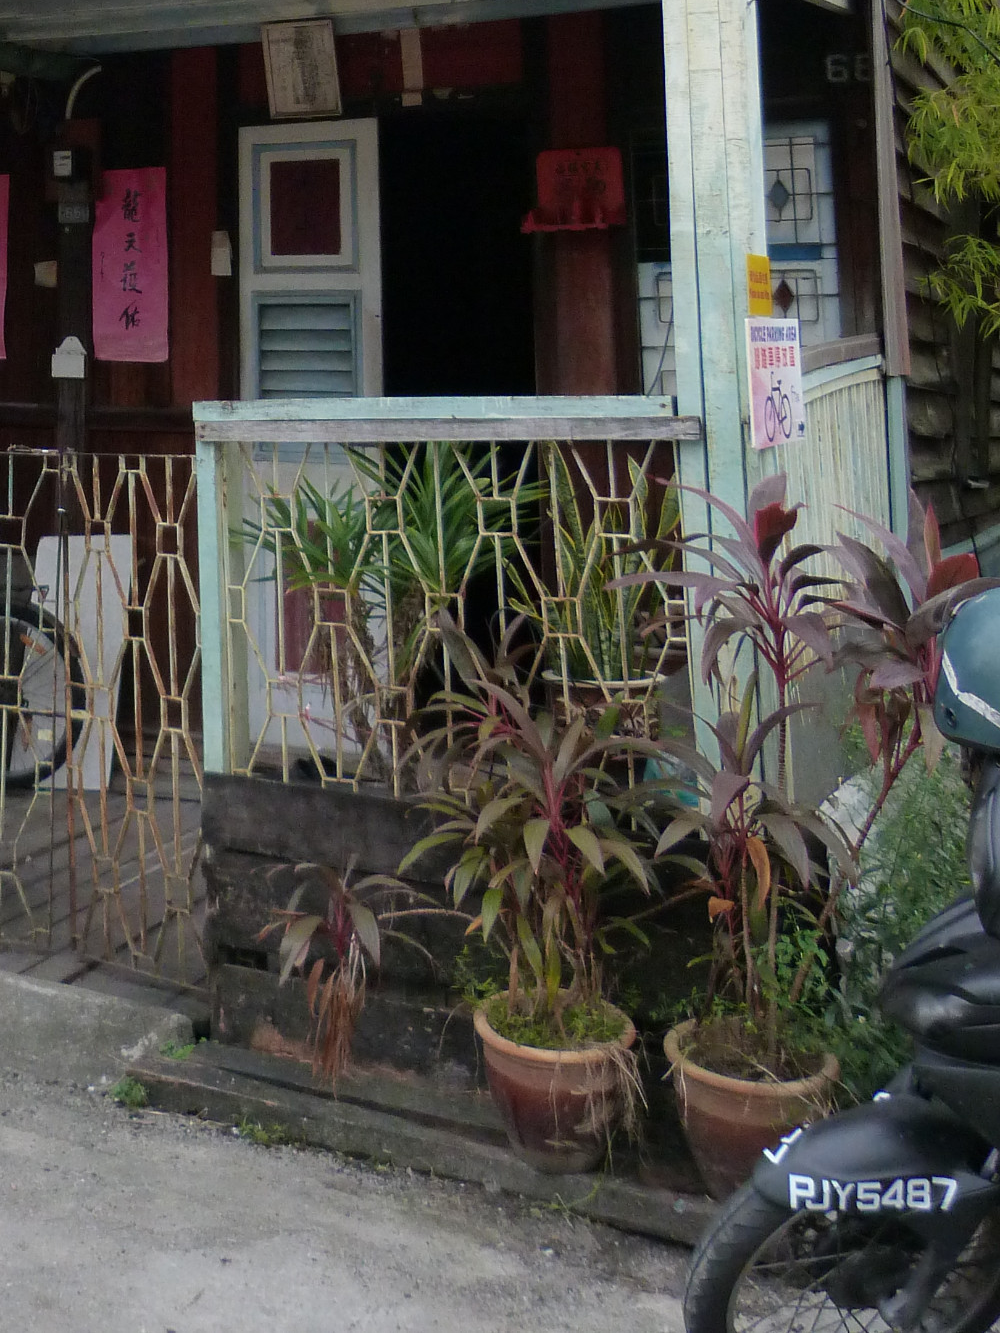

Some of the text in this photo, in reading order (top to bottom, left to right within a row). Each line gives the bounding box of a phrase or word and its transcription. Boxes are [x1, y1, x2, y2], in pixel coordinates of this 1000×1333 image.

[766, 326, 785, 342] PARKING
[785, 326, 797, 342] AREA
[787, 1173, 958, 1212] PJY5487
